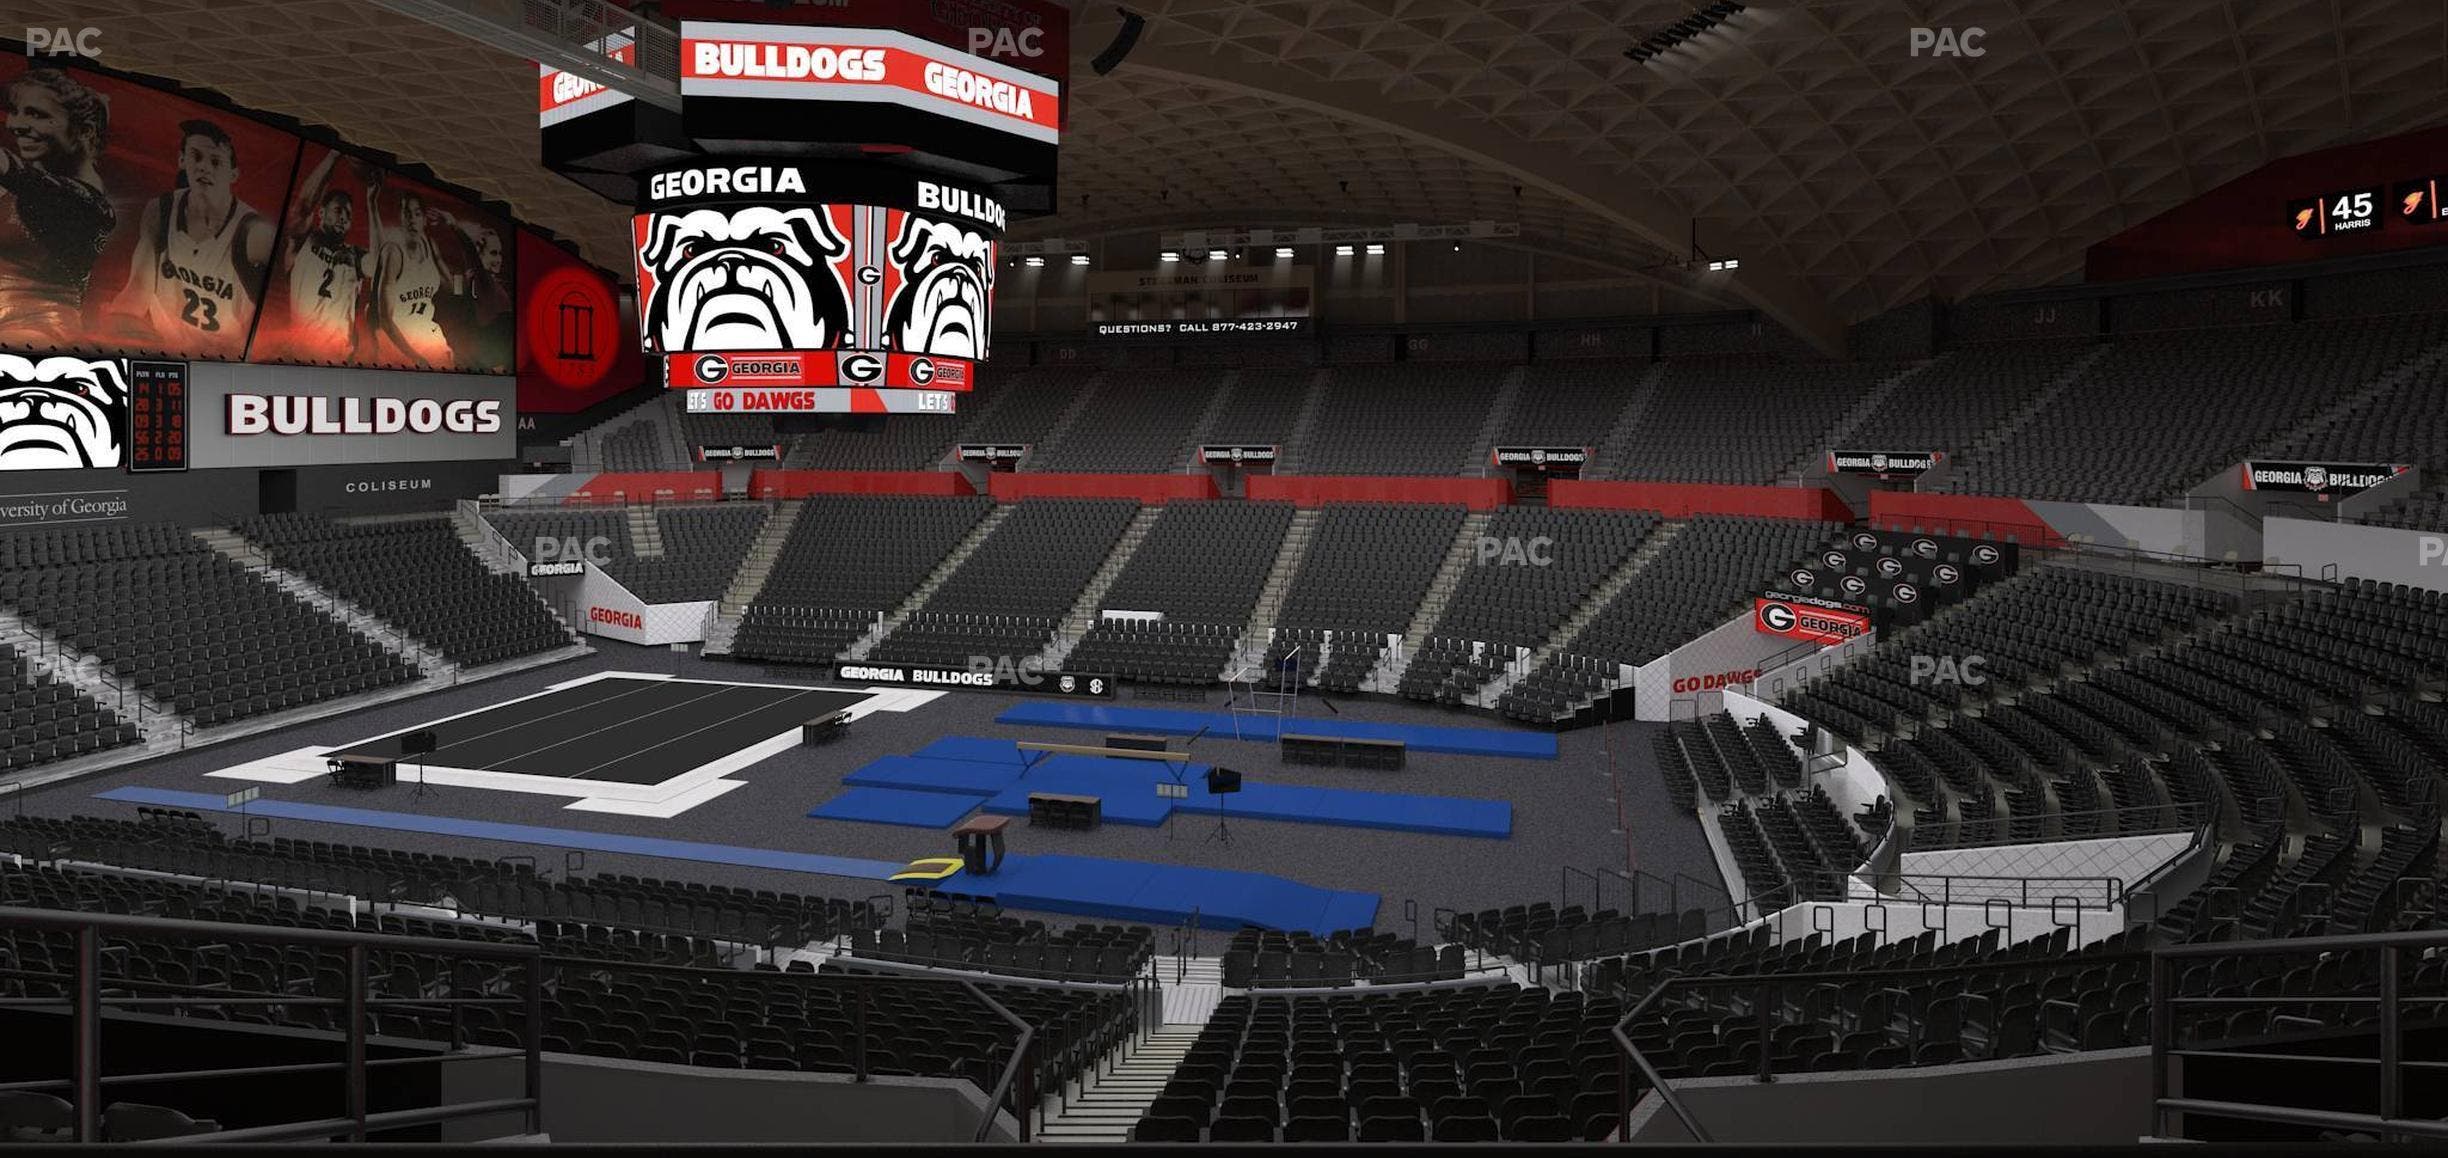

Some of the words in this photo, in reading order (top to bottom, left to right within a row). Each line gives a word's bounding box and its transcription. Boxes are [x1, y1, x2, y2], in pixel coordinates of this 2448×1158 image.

[694, 42, 886, 82] BULLDOGS
[924, 62, 1034, 119] GEORGIA
[651, 166, 806, 200] GEORGIA
[2332, 192, 2374, 220] 45
[2335, 218, 2371, 231] HARRIS
[318, 269, 334, 298] 2
[2250, 289, 2284, 308] KK
[181, 288, 220, 331] 23
[1099, 324, 1172, 336] QUESTIONS?
[1179, 322, 1209, 333] CALL
[1212, 321, 1298, 332] 877-423-2947
[732, 362, 800, 375] GEORGIA
[714, 392, 735, 410] GO
[743, 391, 816, 410] DAWGS
[227, 394, 501, 434] BULLDOGS
[518, 418, 536, 430] AA
[1500, 452, 1530, 462] GEORGIA
[1546, 452, 1584, 462] BULLDOGS
[1837, 457, 1870, 468] GEORGIA
[345, 479, 433, 493] COLISEUM
[2254, 470, 2301, 484] GEORGIA
[52, 498, 70, 515] of
[70, 496, 127, 516] Georgia
[531, 562, 584, 576] GEORGIA
[591, 607, 643, 629] GEORGIA
[1800, 616, 1861, 637] GEORGIA
[839, 666, 905, 682] GEORGIA
[912, 669, 993, 686] BULLDOGS
[1673, 677, 1701, 693] GO
